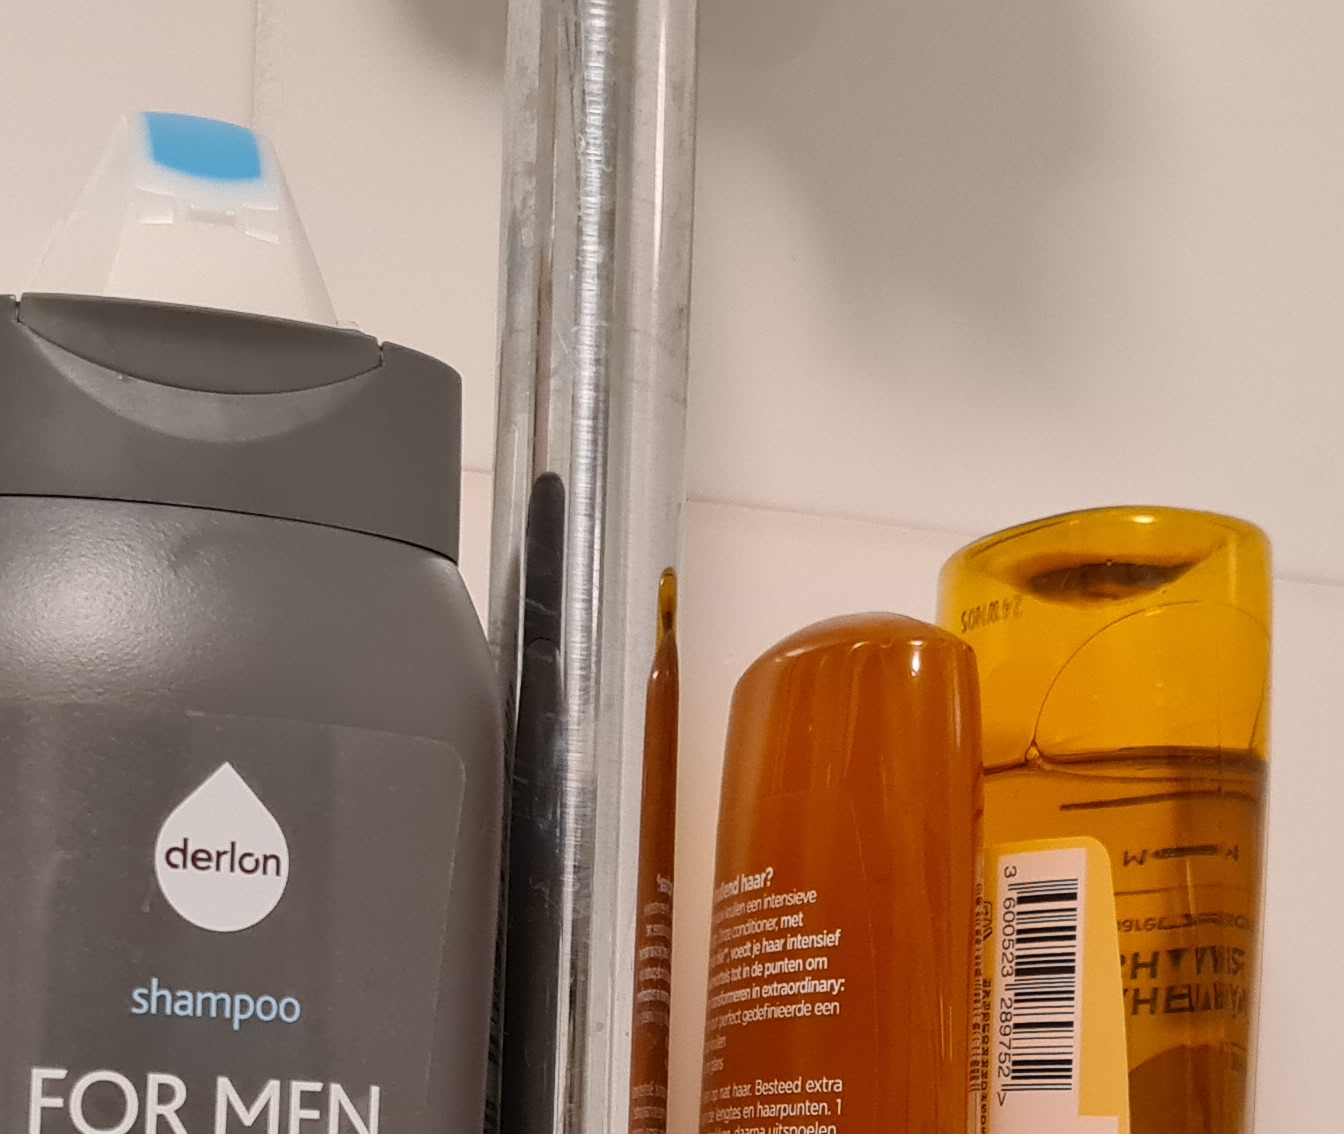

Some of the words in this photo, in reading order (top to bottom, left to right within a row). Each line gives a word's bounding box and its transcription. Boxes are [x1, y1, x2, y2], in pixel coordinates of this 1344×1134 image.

[165, 838, 281, 877] derlon
[741, 866, 775, 894] haar?
[1004, 865, 1018, 878] 3
[746, 898, 762, 913] een
[763, 888, 817, 911] intensieve
[780, 911, 804, 929] met
[752, 938, 761, 958] je
[762, 938, 785, 954] haar
[787, 928, 842, 950] intensief
[1000, 896, 1016, 978] 600523
[743, 963, 750, 978] in
[751, 961, 763, 977] de
[764, 957, 804, 979] punten
[805, 957, 828, 972] om
[752, 983, 761, 999] in
[761, 977, 846, 998] extraordinary:
[131, 978, 301, 1030] shampoo
[741, 1000, 812, 1026] gedefinieerde
[814, 1001, 840, 1016] een
[997, 997, 1013, 1078] 289752
[755, 1076, 802, 1097] Besteed
[806, 1076, 843, 1094] extra
[743, 1105, 755, 1119] en
[757, 1100, 832, 1121] haarpunten.
[835, 1098, 842, 1116] 1
